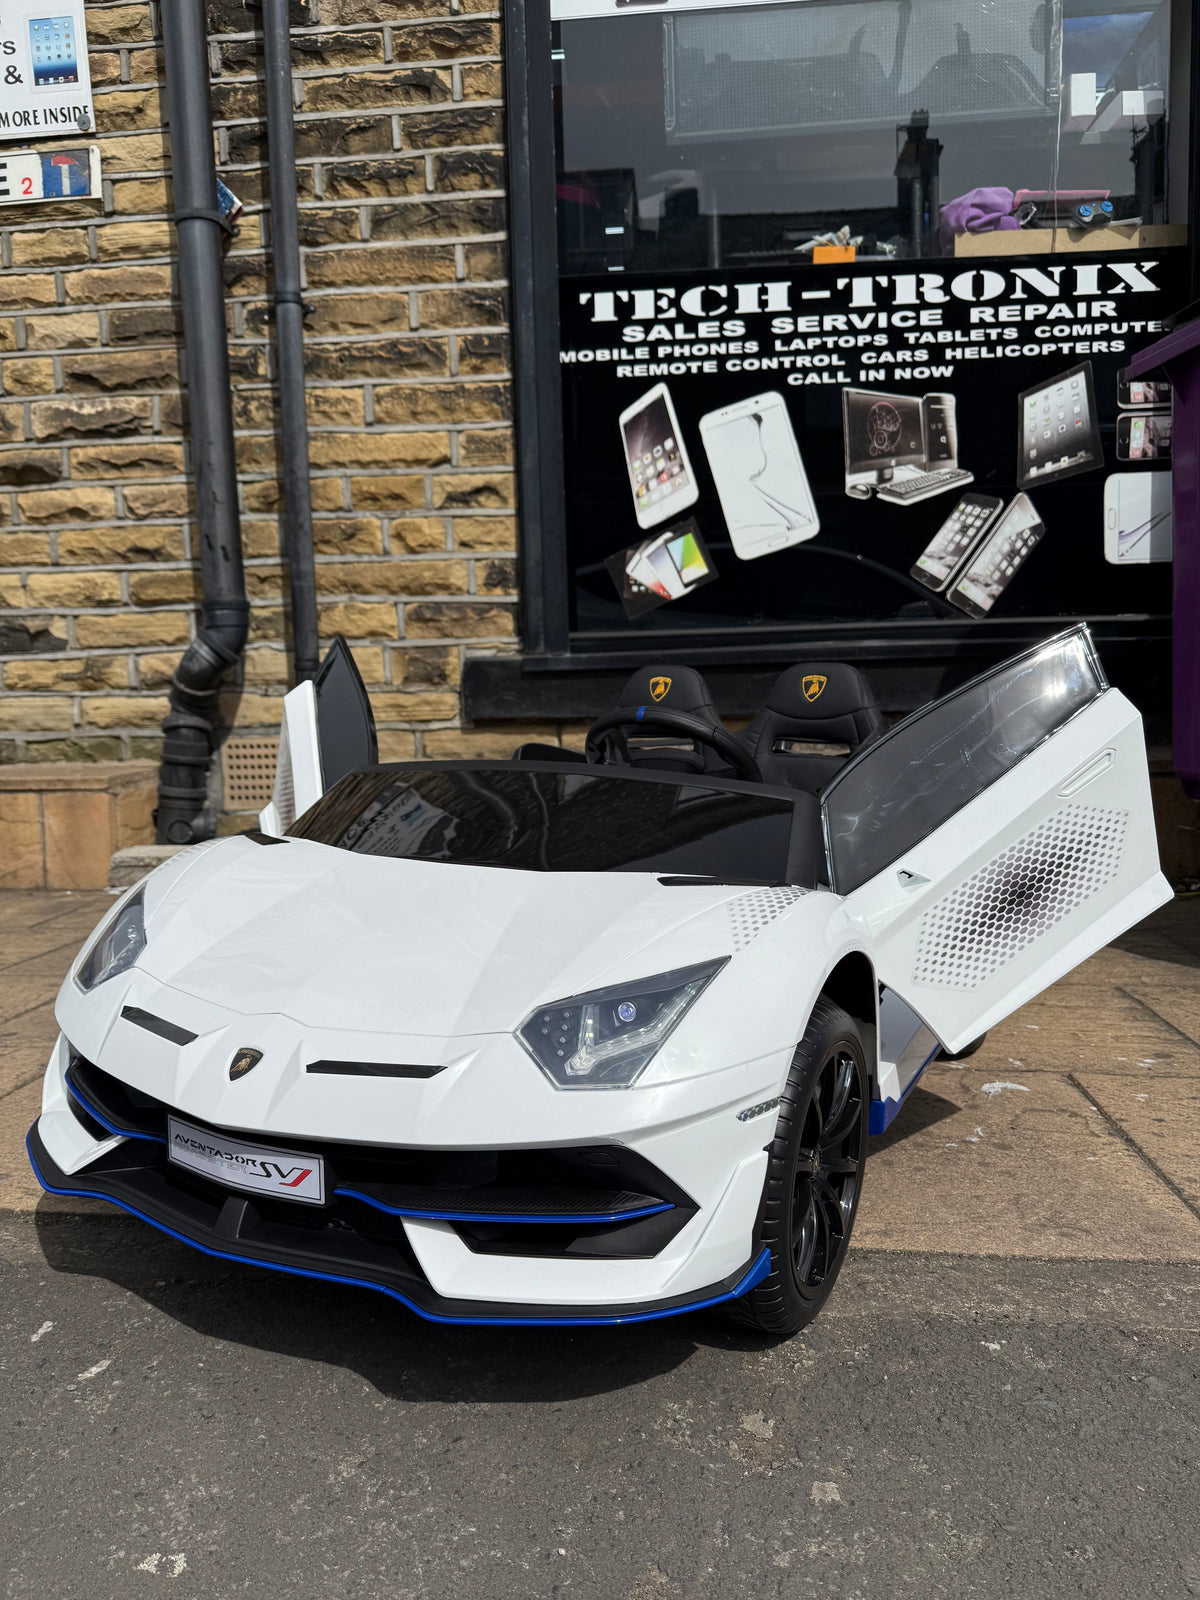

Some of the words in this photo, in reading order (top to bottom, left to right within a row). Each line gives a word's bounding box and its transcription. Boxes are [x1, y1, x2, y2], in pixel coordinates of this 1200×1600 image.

[4, 65, 24, 85] &
[0, 109, 40, 128] MORE
[21, 177, 33, 195] 2
[578, 261, 1161, 323] TECH-TRONIX
[621, 319, 747, 343] SALES
[770, 308, 943, 335] SERVICE
[969, 300, 1118, 324] REPAIR
[559, 346, 650, 364] MOBILE
[657, 340, 760, 359] PHONES
[774, 333, 889, 352] LAPTOPS
[903, 327, 1019, 345] TABLETS
[1034, 320, 1170, 339] COMPUTE
[616, 360, 718, 378] REMOTE
[725, 353, 846, 372] CONTROL
[860, 349, 929, 365] CARS
[945, 339, 1126, 361] HELICOPTERS
[787, 371, 852, 386] CALL
[859, 368, 886, 382] IN
[894, 365, 954, 380] NOW
[174, 1133, 257, 1168] AVENTADOR
[249, 1161, 313, 1188] SVJ
